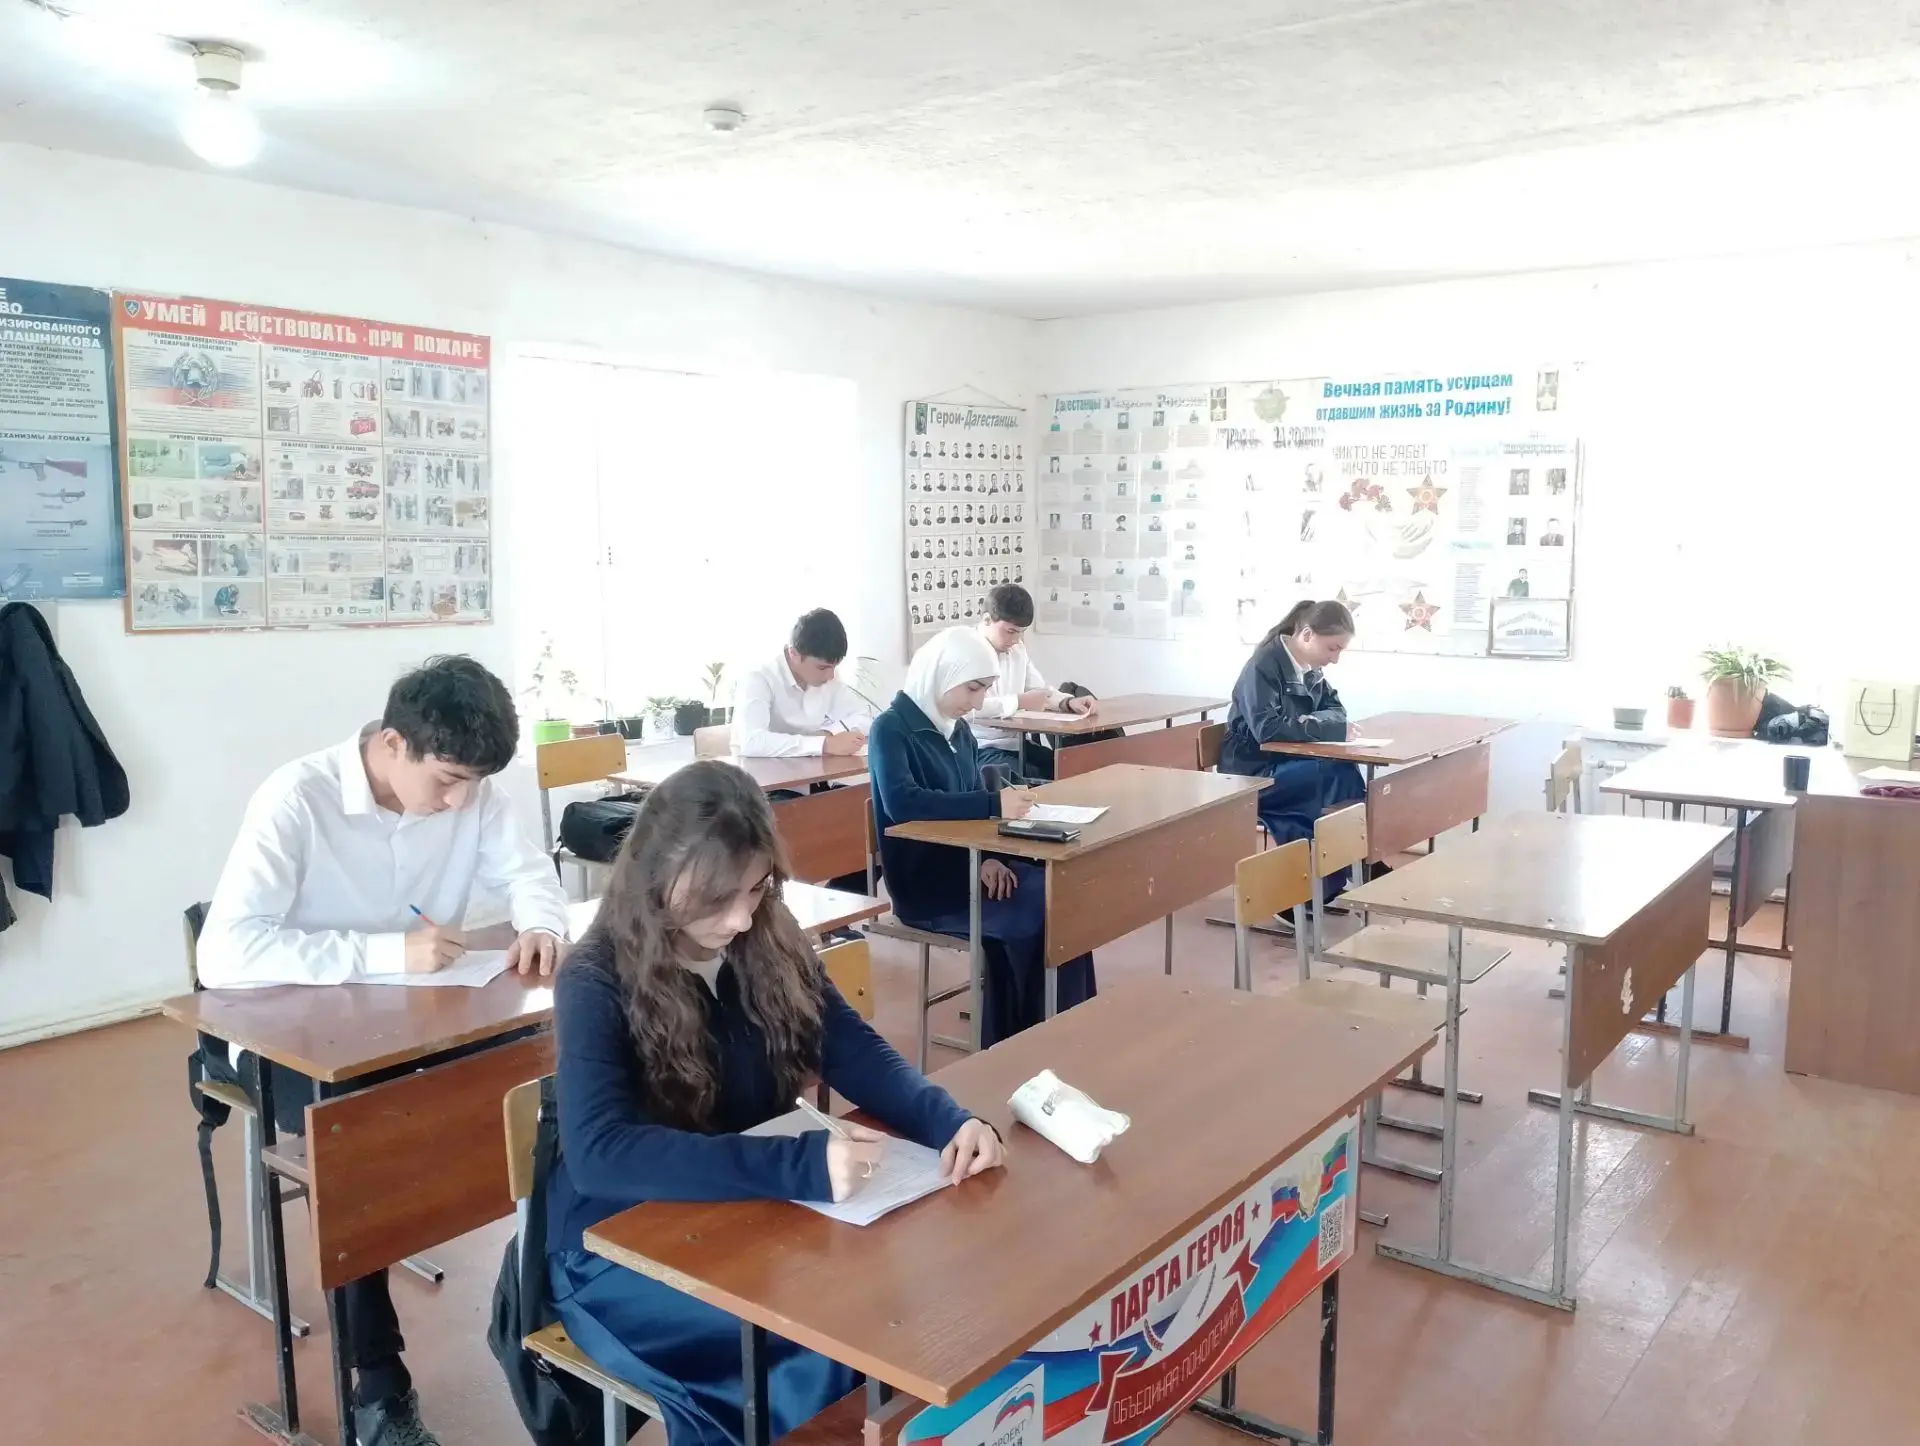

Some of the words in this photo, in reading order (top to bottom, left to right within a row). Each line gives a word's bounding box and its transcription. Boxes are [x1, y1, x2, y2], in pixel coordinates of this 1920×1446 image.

[0, 330, 102, 349] ЛАШНИКОВА
[142, 300, 207, 328] УМЕЙ
[219, 310, 357, 345] ДЕЙСТВОВАТЬ
[368, 328, 405, 351] ПРИ
[413, 333, 484, 360] ПОЖАРЕ
[1316, 405, 1376, 422] отдавшим
[1379, 402, 1423, 419] жизнь
[1425, 402, 1441, 417] за
[1444, 396, 1511, 418] Родину!
[1323, 381, 1381, 398] Вечная
[1384, 378, 1443, 396] память
[1110, 1254, 1182, 1343] ПАРТА
[1186, 1200, 1245, 1280] ГЕРОЯ
[1112, 1366, 1180, 1425] ОБЪЕДИНЯЯ
[1181, 1299, 1239, 1382] ПОКОЛЕНИЯ
